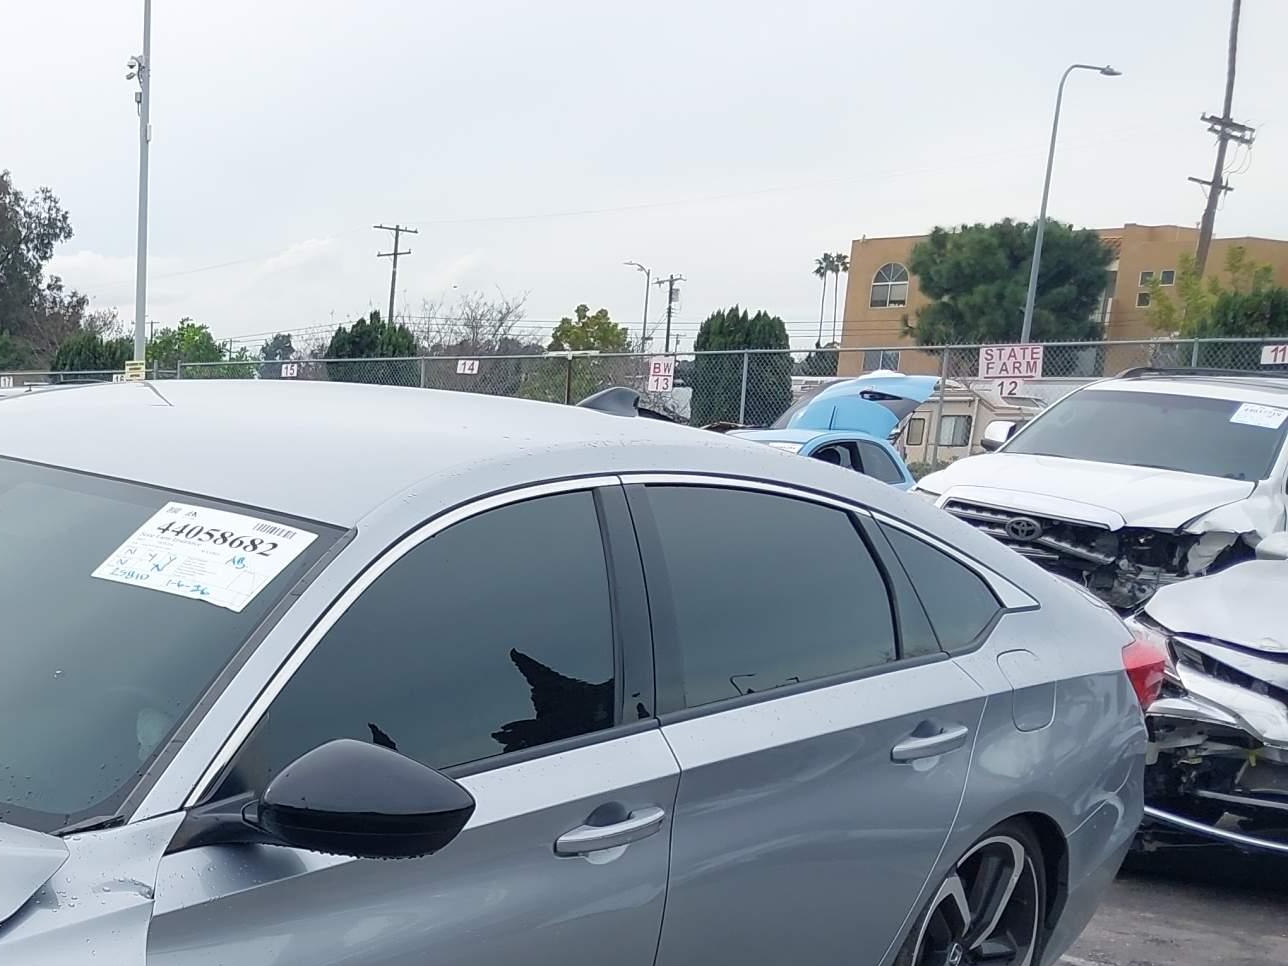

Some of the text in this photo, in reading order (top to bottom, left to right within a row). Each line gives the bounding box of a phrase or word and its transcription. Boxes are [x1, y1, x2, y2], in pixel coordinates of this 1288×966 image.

[984, 347, 1041, 362] STATE
[1271, 346, 1287, 363] 11
[284, 364, 295, 376] 15
[462, 361, 475, 373] 14
[985, 361, 1038, 375] FARM
[654, 377, 669, 390] 13
[998, 381, 1018, 396] 12
[157, 521, 278, 557] 44058682
